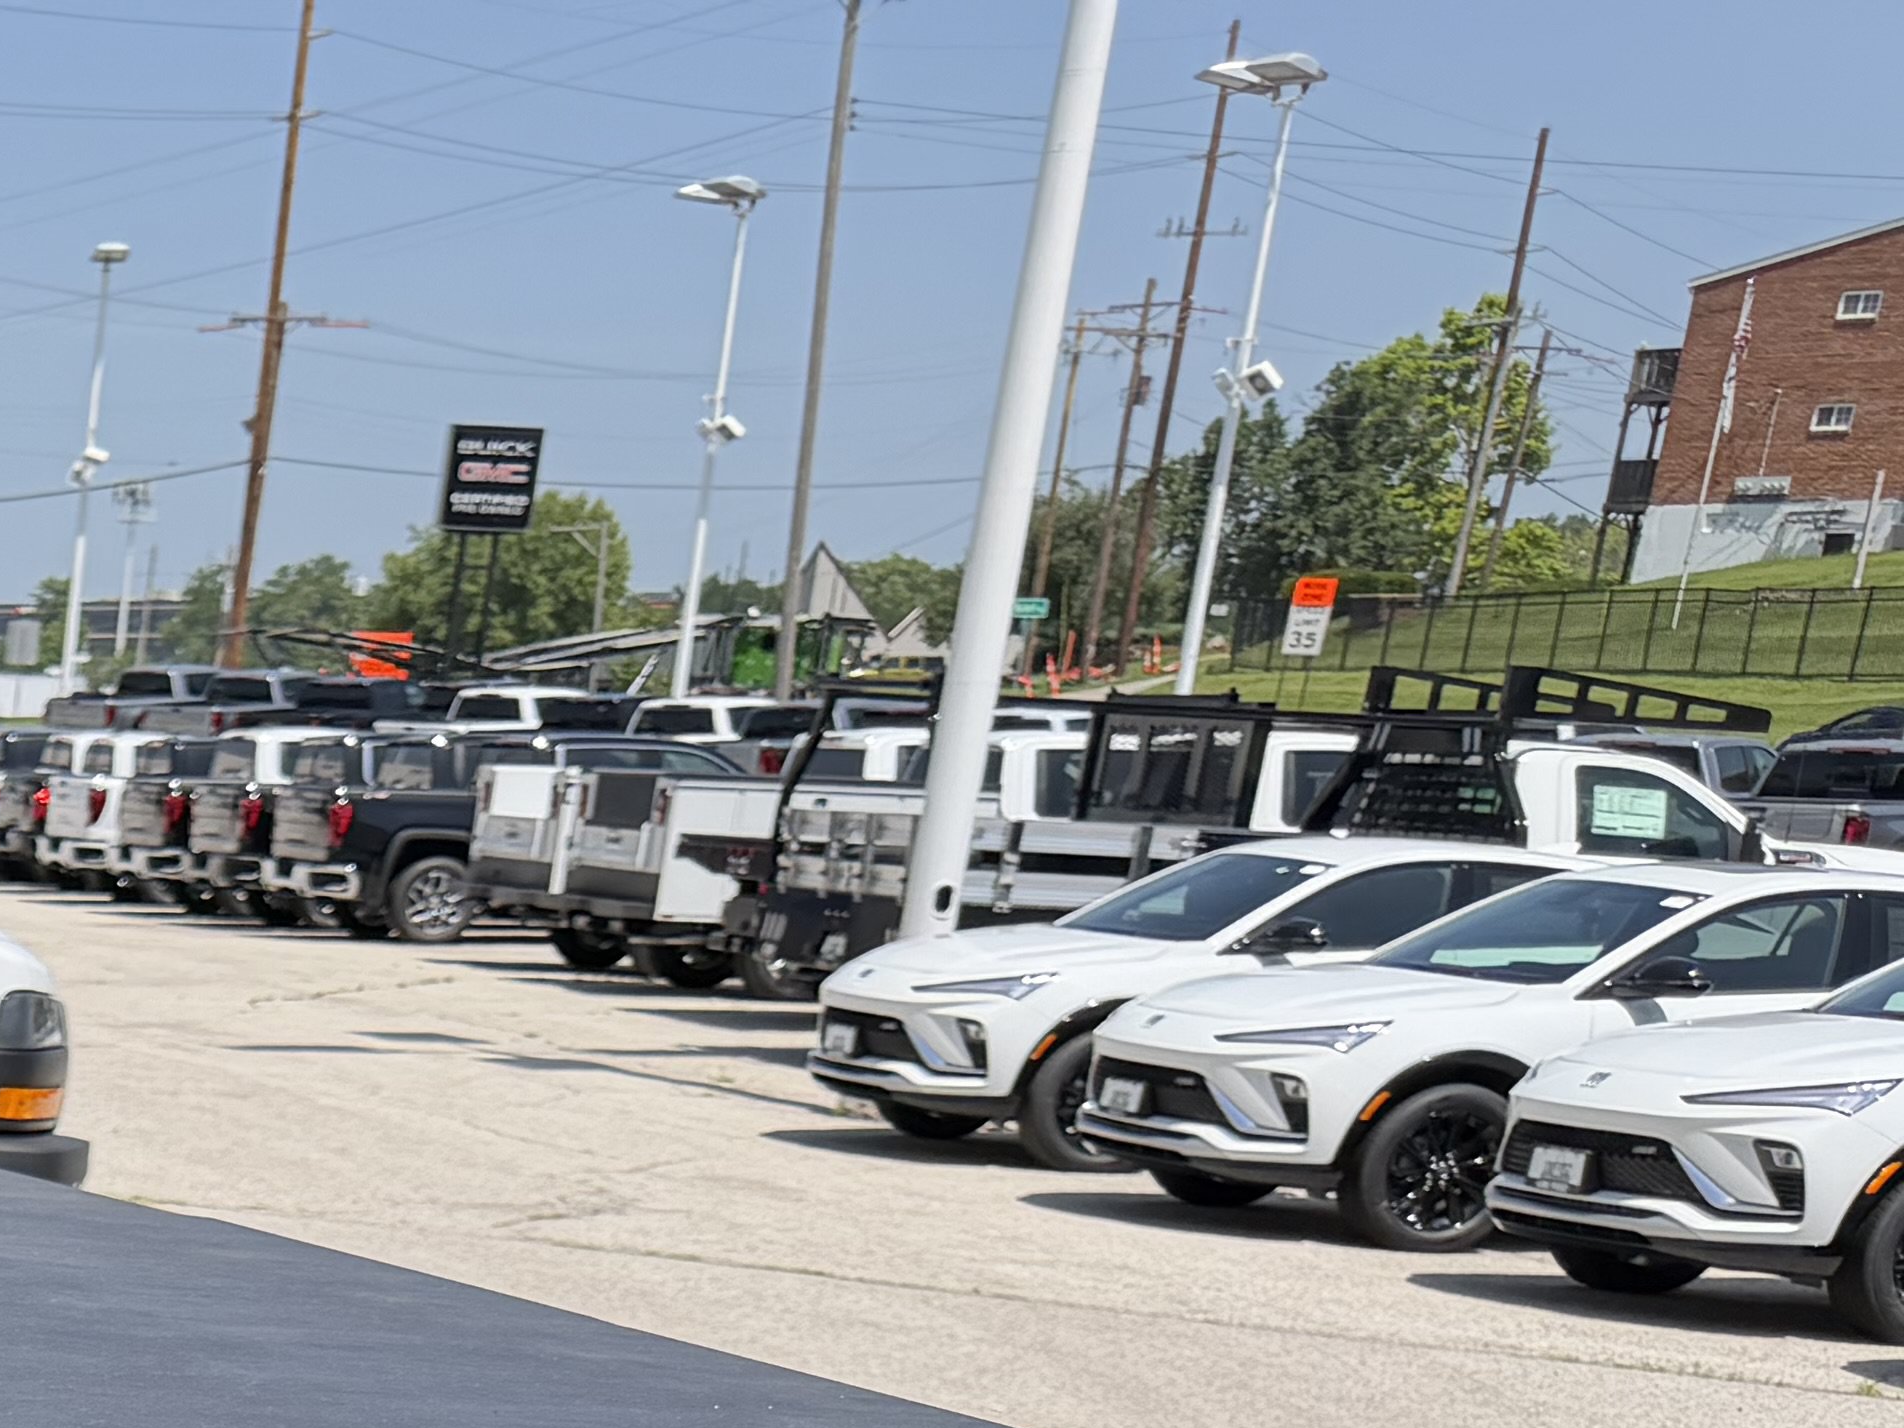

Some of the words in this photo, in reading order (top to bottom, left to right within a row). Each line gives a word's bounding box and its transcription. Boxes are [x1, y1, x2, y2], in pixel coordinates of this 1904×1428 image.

[456, 439, 537, 457] BUICK
[457, 461, 532, 485] GMC
[1288, 630, 1318, 649] 35
